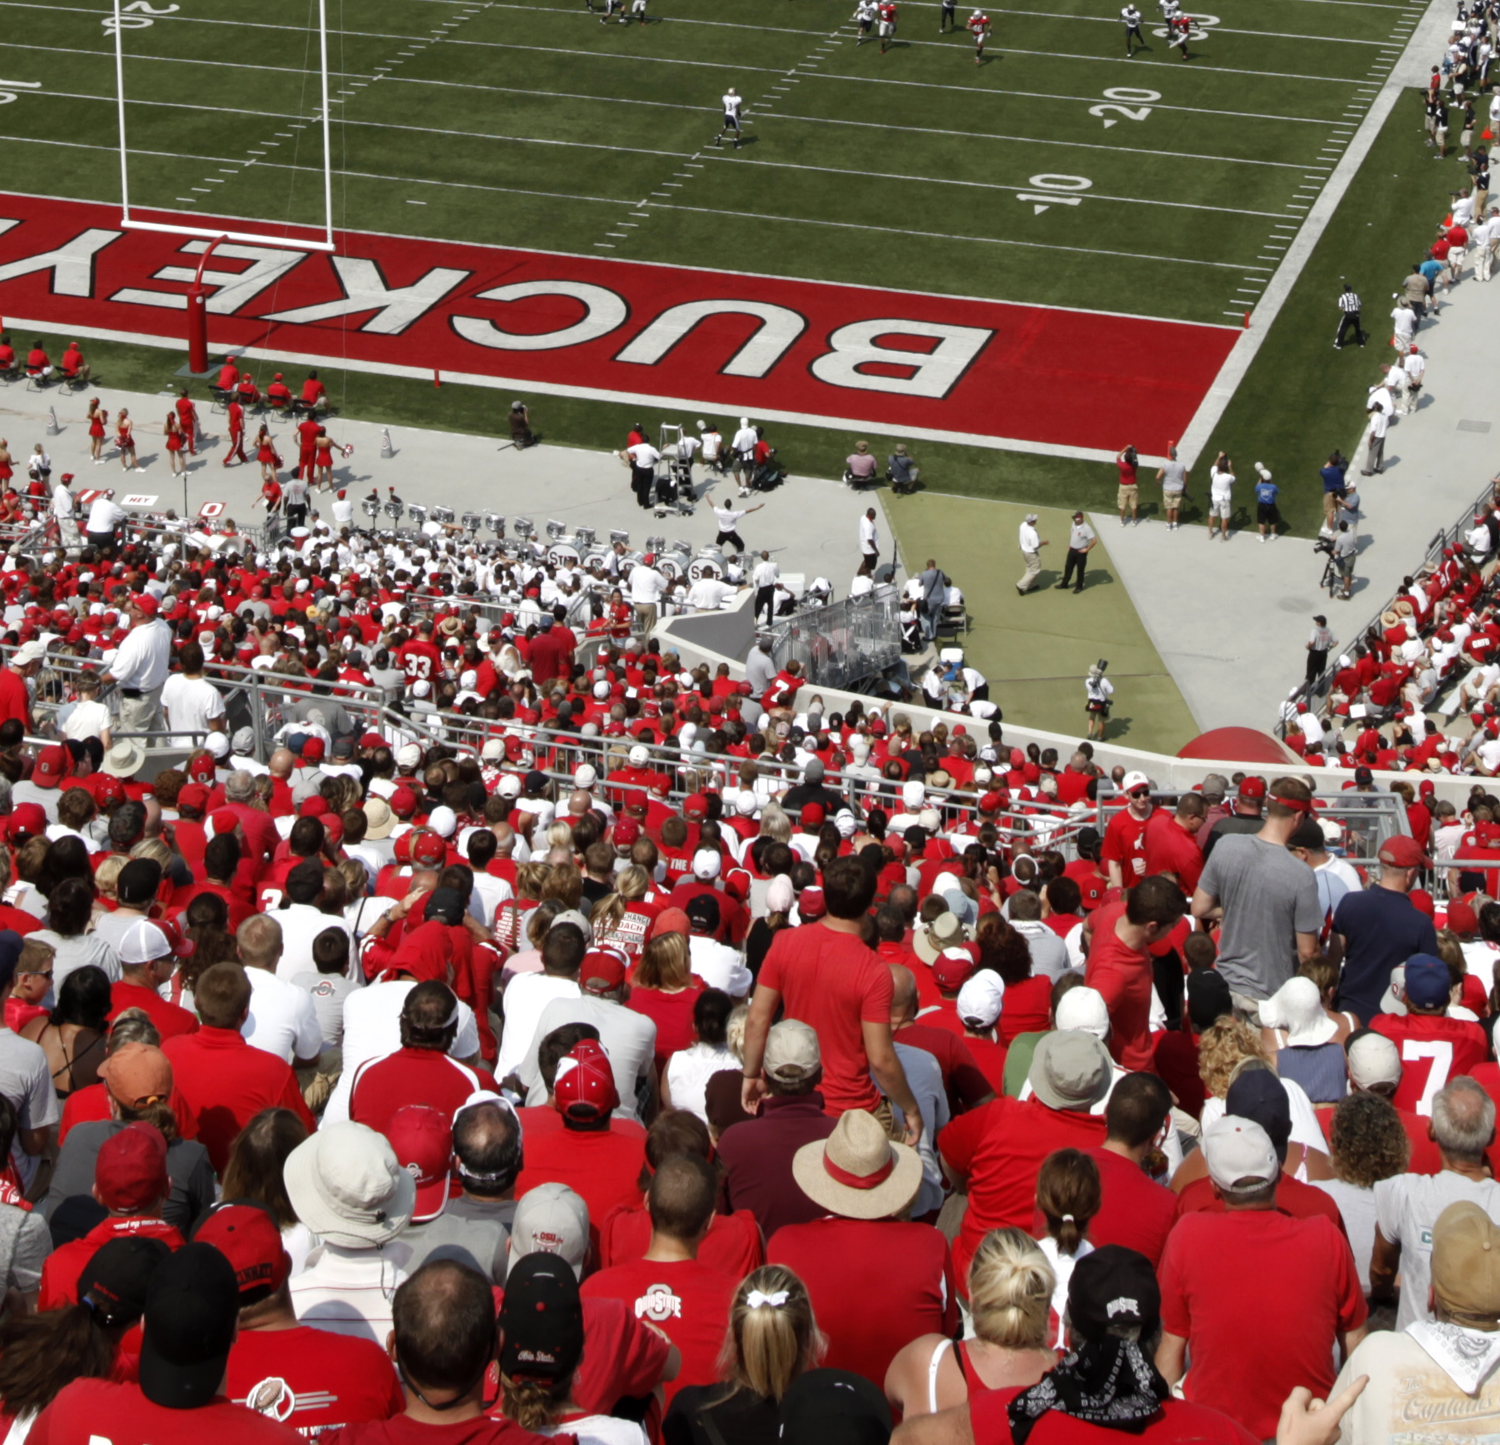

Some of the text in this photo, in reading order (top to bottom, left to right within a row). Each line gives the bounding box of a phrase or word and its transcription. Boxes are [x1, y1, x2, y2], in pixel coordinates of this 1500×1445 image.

[101, 0, 181, 30] 20
[1088, 87, 1163, 122] 20
[1016, 173, 1093, 206] 10
[404, 652, 431, 680] 33
[670, 858, 687, 871] THE
[1402, 1039, 1454, 1117] 7
